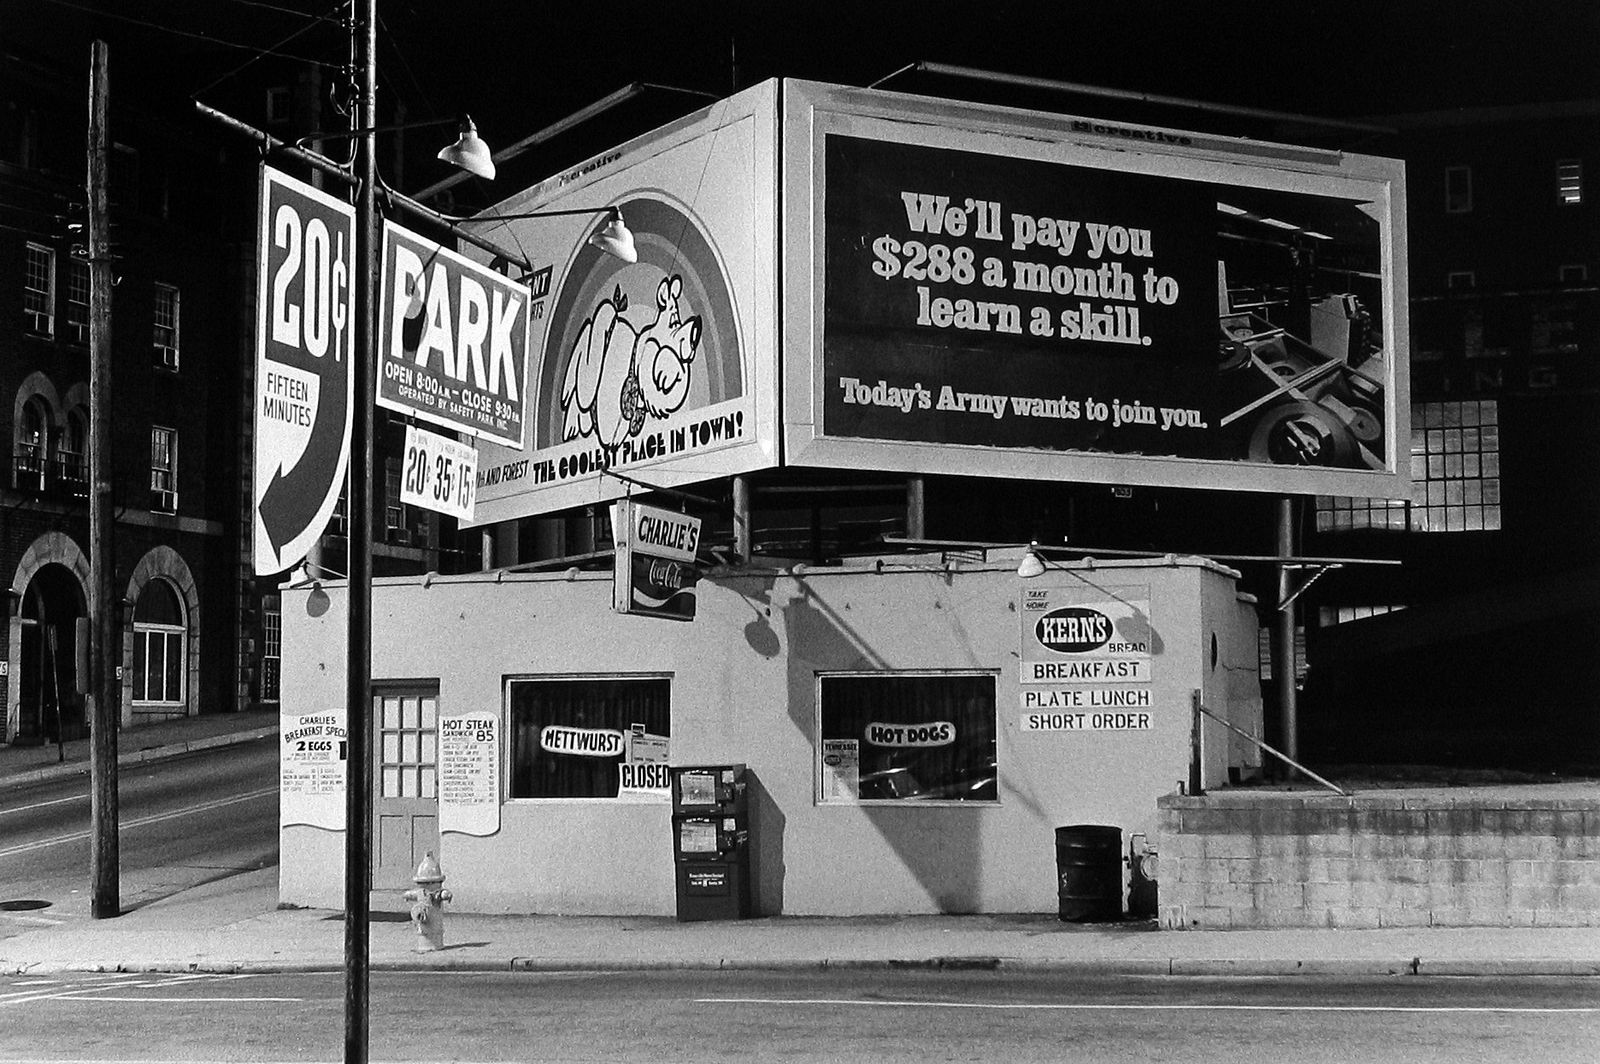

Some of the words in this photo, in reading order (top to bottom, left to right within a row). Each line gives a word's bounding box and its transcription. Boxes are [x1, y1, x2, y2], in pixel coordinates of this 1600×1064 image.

[901, 191, 1003, 241] We'll
[1011, 213, 1080, 256] pay
[1086, 222, 1153, 258] you
[872, 234, 975, 285] $288
[982, 257, 1007, 288] a
[1012, 261, 1136, 301] month
[1143, 267, 1179, 305] to
[391, 244, 522, 402] PARK
[917, 286, 1022, 334] learn
[1030, 305, 1054, 337] a
[1060, 302, 1152, 346] skill.
[267, 372, 308, 402] FIFTEEN
[385, 361, 413, 386] OPEN
[461, 389, 492, 414] CLOSE
[263, 395, 311, 427] MINUTES
[398, 385, 435, 406] OPERATED
[438, 397, 448, 410] BY
[450, 402, 475, 419] SAFETY
[477, 411, 494, 426] PARK
[840, 377, 931, 412] Today's
[936, 386, 1008, 419] Army
[1010, 396, 1080, 419] wants
[1085, 397, 1108, 421] to
[1113, 399, 1157, 427] join
[1161, 406, 1208, 431] you.
[533, 458, 556, 484] THE
[558, 447, 618, 479] COOLEST
[622, 432, 666, 464] PLACE
[670, 427, 685, 453] IN
[690, 410, 743, 448] TOWN!
[485, 466, 501, 486] AND
[501, 459, 529, 482] FOREST
[1109, 642, 1146, 653] BREAD
[1034, 662, 1140, 679] BREAKFAST
[1026, 691, 1083, 707] PLATE
[1091, 690, 1149, 706] LUNCH
[443, 719, 463, 730] HOT
[466, 719, 494, 730] STEAK
[871, 725, 904, 744] HOT
[908, 724, 949, 743] DOGS
[1029, 713, 1085, 730] SHORT
[1092, 713, 1149, 730] ORDER
[284, 726, 323, 743] BREAKFAST
[296, 741, 306, 751] 2
[308, 741, 332, 751] EGGS
[476, 729, 494, 742] 85
[545, 730, 621, 752] METTWURST
[622, 764, 671, 788] CLOSED
